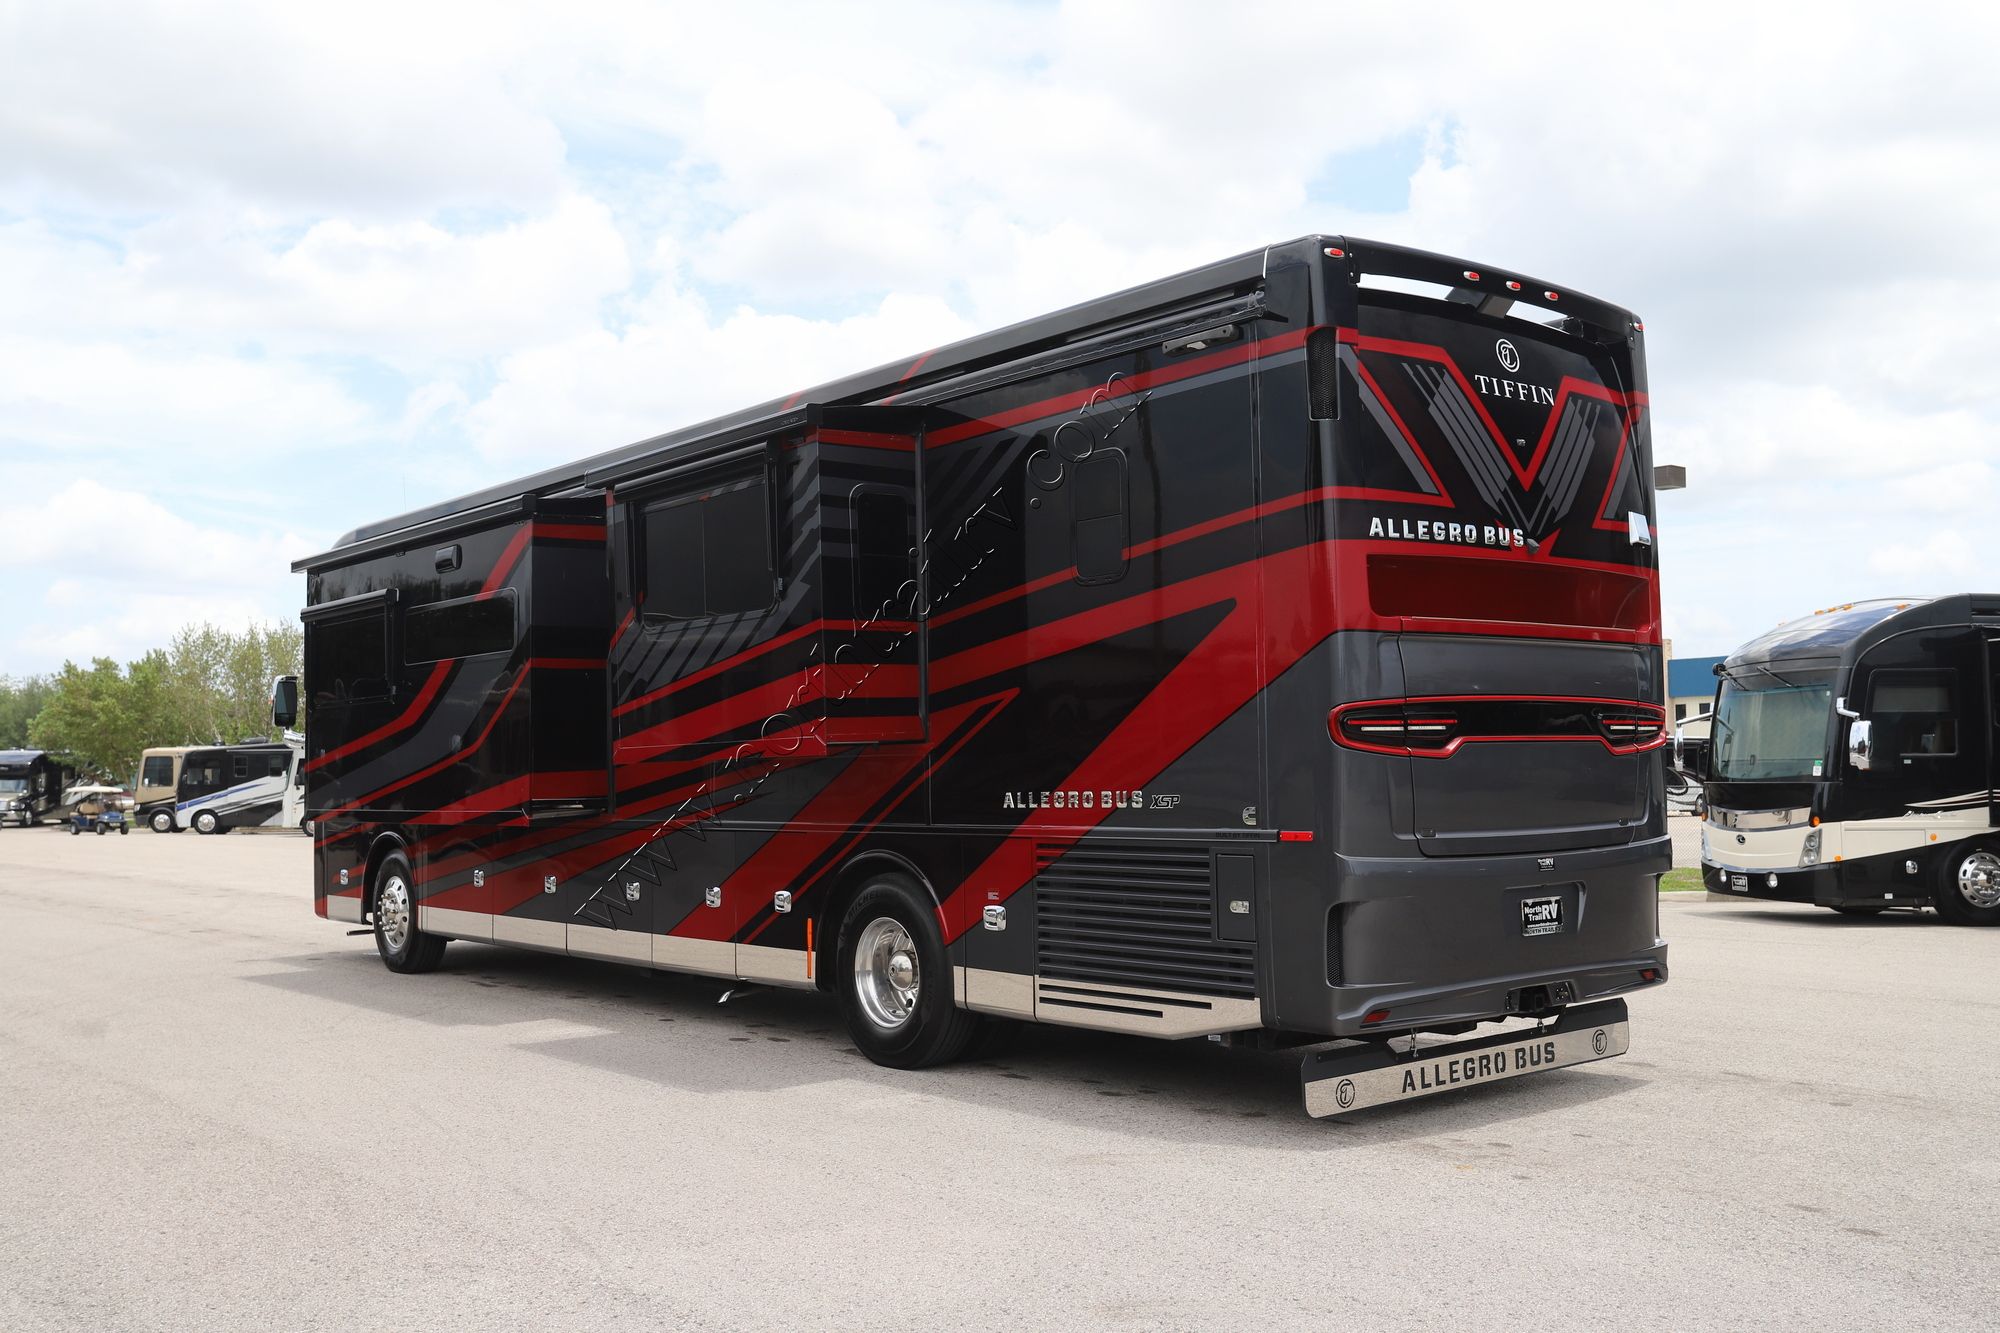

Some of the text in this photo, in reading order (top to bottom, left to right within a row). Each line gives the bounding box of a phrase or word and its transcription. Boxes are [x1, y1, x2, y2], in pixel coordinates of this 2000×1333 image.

[1474, 374, 1555, 406] TIFFIN
[1368, 517, 1525, 548] ALLEGRO BUS
[1003, 790, 1181, 809] ALLEGRO BUS XSP
[1524, 903, 1558, 920] North RV
[1528, 913, 1543, 921] Trail
[1401, 1041, 1555, 1094] ALLEGRO BUS
